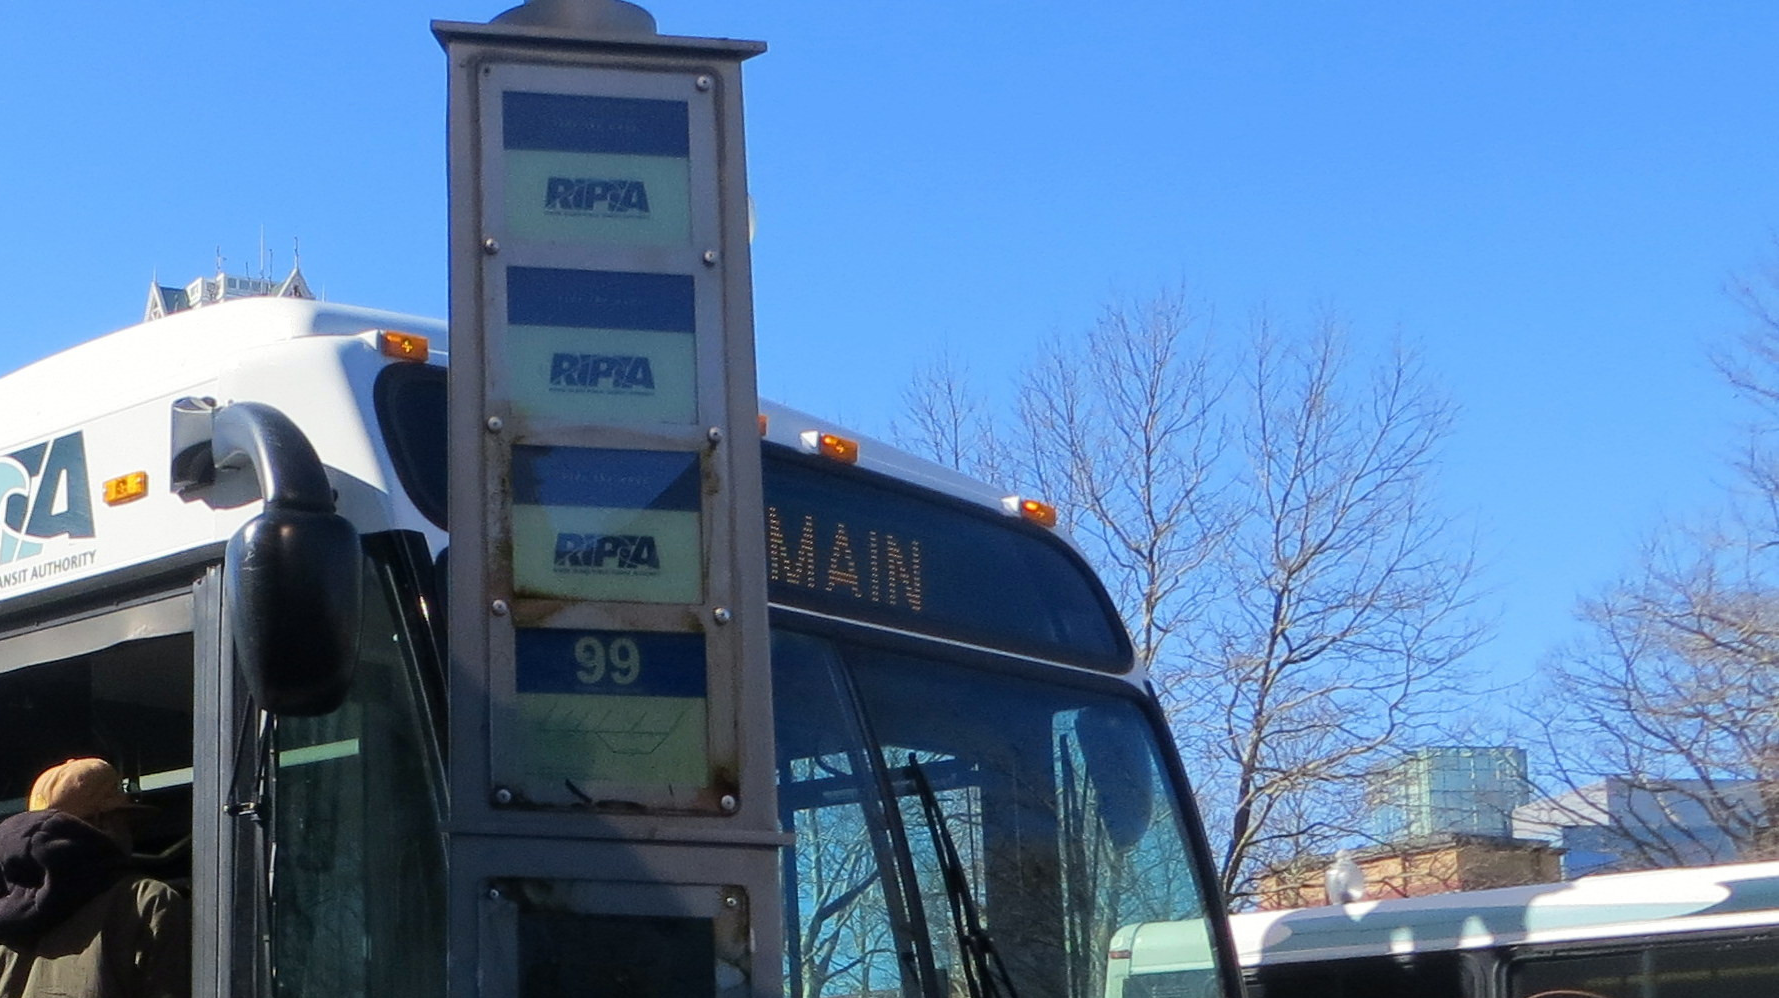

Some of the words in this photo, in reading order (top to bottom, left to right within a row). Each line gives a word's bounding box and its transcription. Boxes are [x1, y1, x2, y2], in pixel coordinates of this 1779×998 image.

[544, 176, 651, 214] RIPTA
[549, 352, 656, 390] RIPTA
[29, 548, 97, 581] AUTHORITY
[553, 531, 661, 570] RIPTA
[769, 506, 922, 612] MAIN
[574, 635, 641, 686] 99
